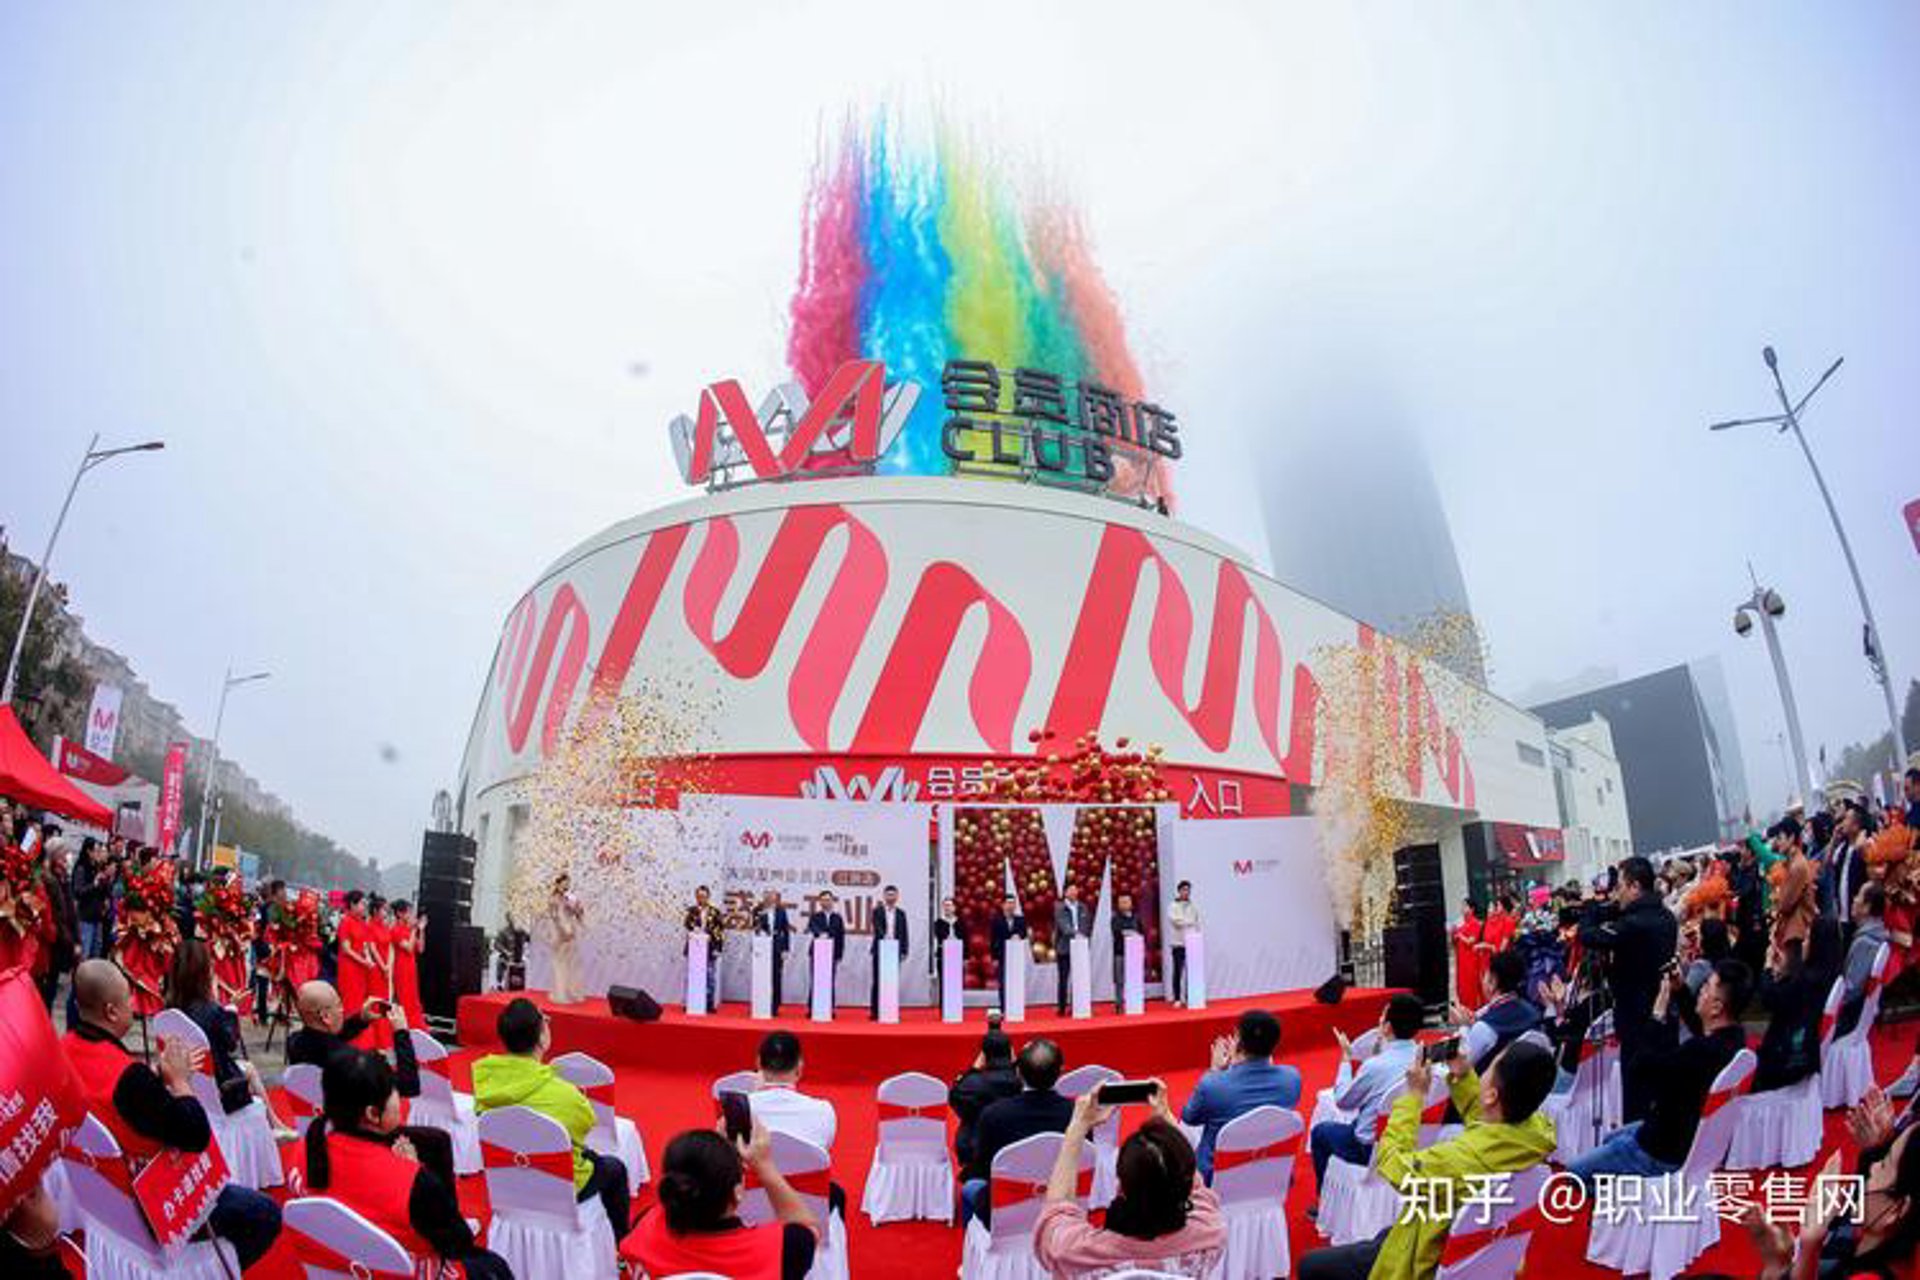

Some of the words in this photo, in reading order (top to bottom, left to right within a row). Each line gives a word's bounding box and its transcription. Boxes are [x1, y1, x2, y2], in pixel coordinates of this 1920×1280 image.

[942, 360, 1182, 459] 会员商店
[942, 416, 1115, 482] CLUB
[1187, 777, 1244, 813] 入口
